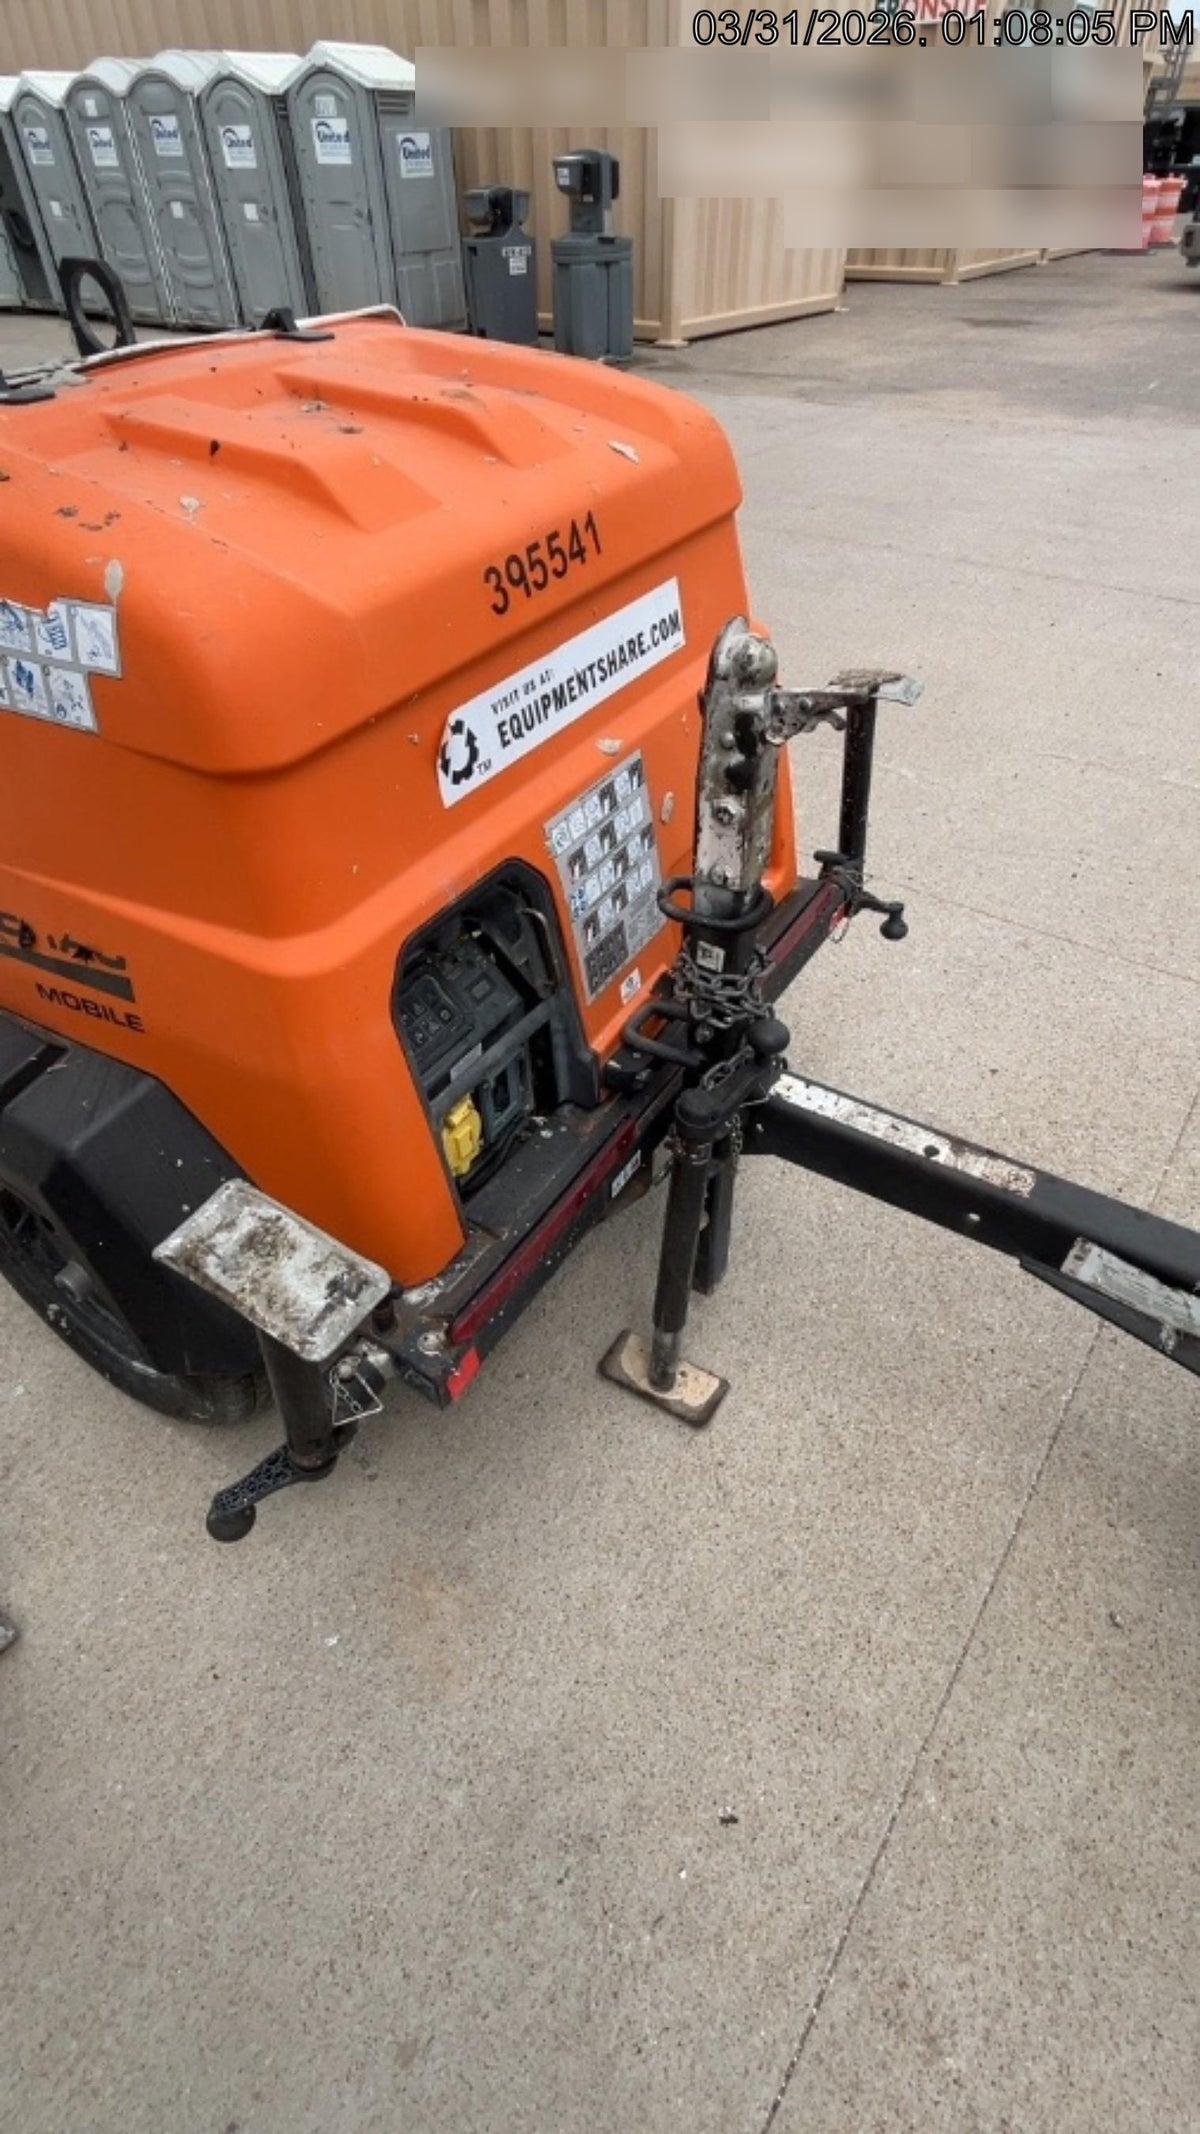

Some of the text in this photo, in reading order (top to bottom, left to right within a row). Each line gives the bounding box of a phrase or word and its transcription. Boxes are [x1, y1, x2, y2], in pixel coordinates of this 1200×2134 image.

[483, 509, 601, 615] 395541
[497, 609, 681, 749] EQUIPMENTSHARE.COM
[35, 981, 146, 1033] MOBILE
